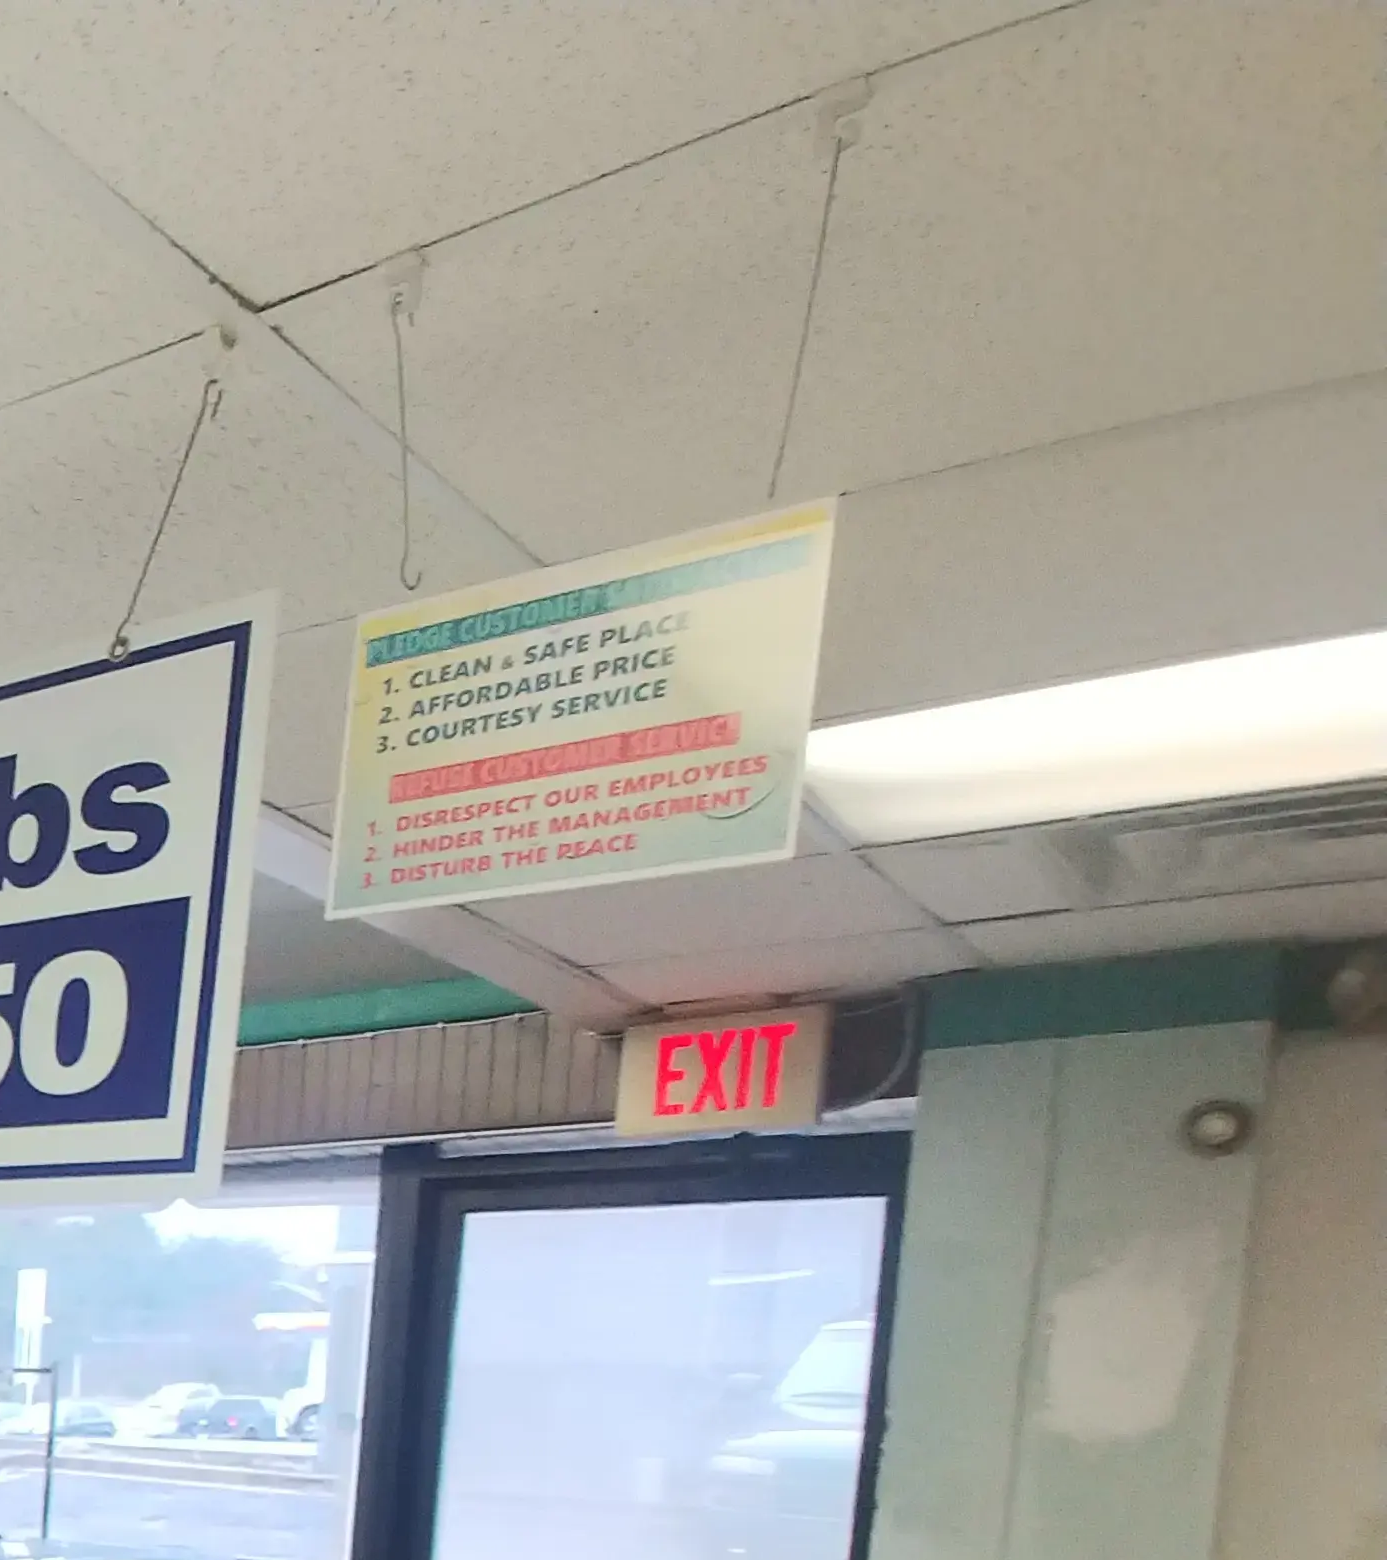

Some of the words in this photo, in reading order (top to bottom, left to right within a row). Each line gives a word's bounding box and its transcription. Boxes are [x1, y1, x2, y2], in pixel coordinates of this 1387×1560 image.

[408, 664, 584, 719] AFFORDABLE
[593, 645, 676, 681] PRICE
[409, 656, 492, 688] CLEAN
[501, 655, 514, 670] &
[523, 633, 590, 666] SAFE
[600, 609, 692, 648] PLACE
[406, 703, 543, 747] COURTESY
[551, 678, 668, 719] SERVICE
[393, 830, 484, 858] HINDER
[493, 821, 540, 842] THE
[548, 787, 752, 834] MANAGEMENT
[396, 794, 537, 832] DISRESPECT
[544, 784, 599, 807] OUR
[608, 755, 770, 797] EMPLOYEES
[390, 855, 491, 885] DISTURB
[502, 846, 548, 869] THE
[556, 833, 638, 860] PEACE
[653, 1021, 798, 1117] EXIT
